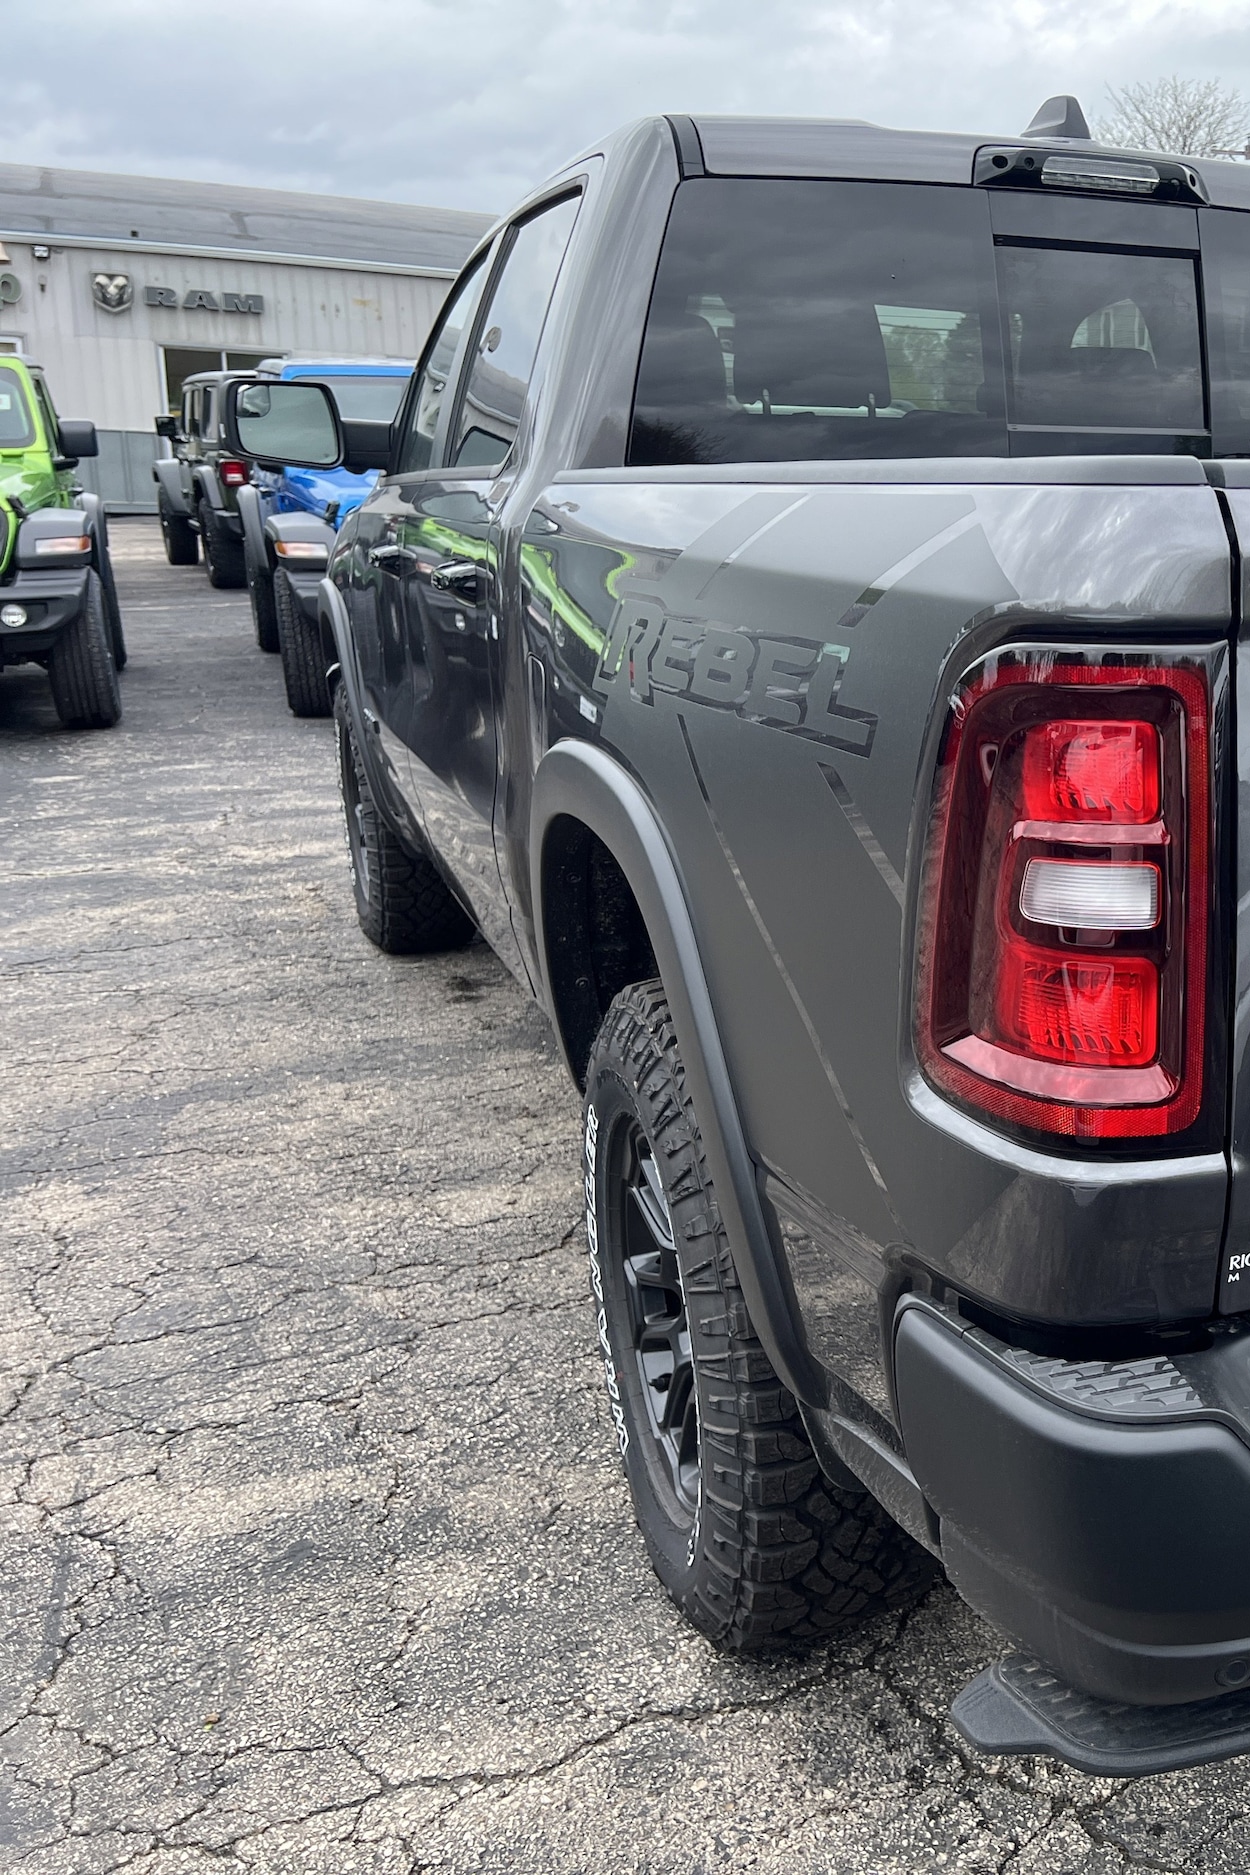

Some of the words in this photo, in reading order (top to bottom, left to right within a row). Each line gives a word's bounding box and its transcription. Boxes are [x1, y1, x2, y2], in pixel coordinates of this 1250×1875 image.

[144, 285, 265, 314] RAM
[592, 591, 879, 759] REBEL
[584, 1103, 630, 1456] WRANGLER
